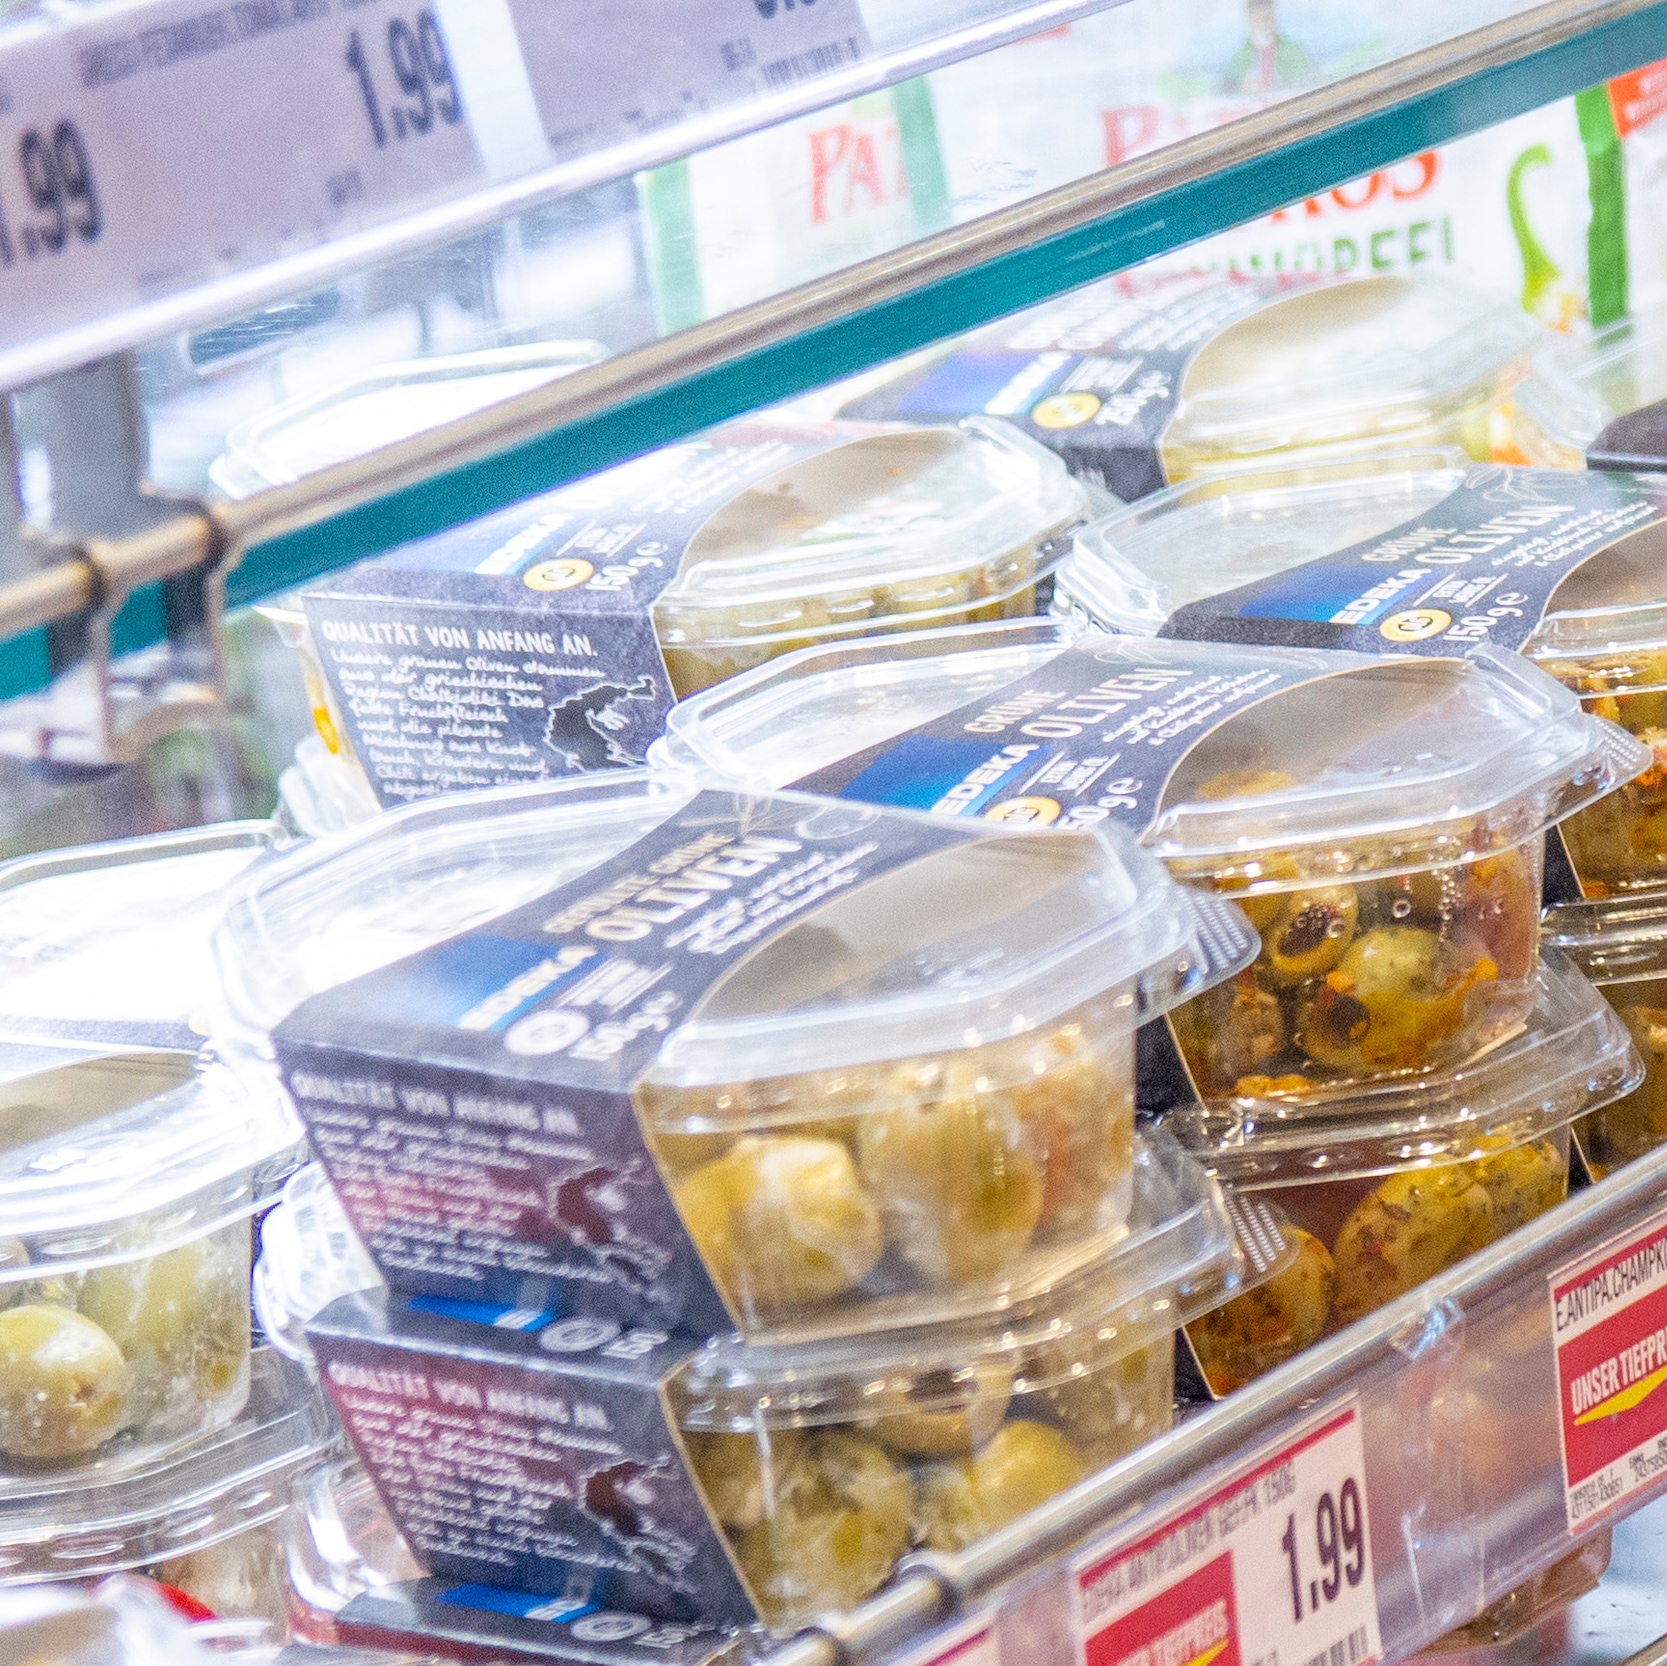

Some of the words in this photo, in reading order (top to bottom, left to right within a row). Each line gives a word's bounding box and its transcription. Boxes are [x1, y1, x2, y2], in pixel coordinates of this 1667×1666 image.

[345, 9, 465, 149] 1.99
[1415, 505, 1577, 564] OLIVEN
[1328, 569, 1433, 624] EDEKA
[322, 621, 419, 646] QUALITÄT
[424, 627, 471, 649] VON
[477, 630, 556, 654] ANFANG
[563, 635, 598, 656] AN.
[1020, 668, 1193, 738] OLIVEN
[929, 743, 1040, 815] EDEKA
[584, 835, 803, 942] OLIVEN
[1570, 1352, 1621, 1416] UNSER
[1279, 1472, 1366, 1628] 1.99
